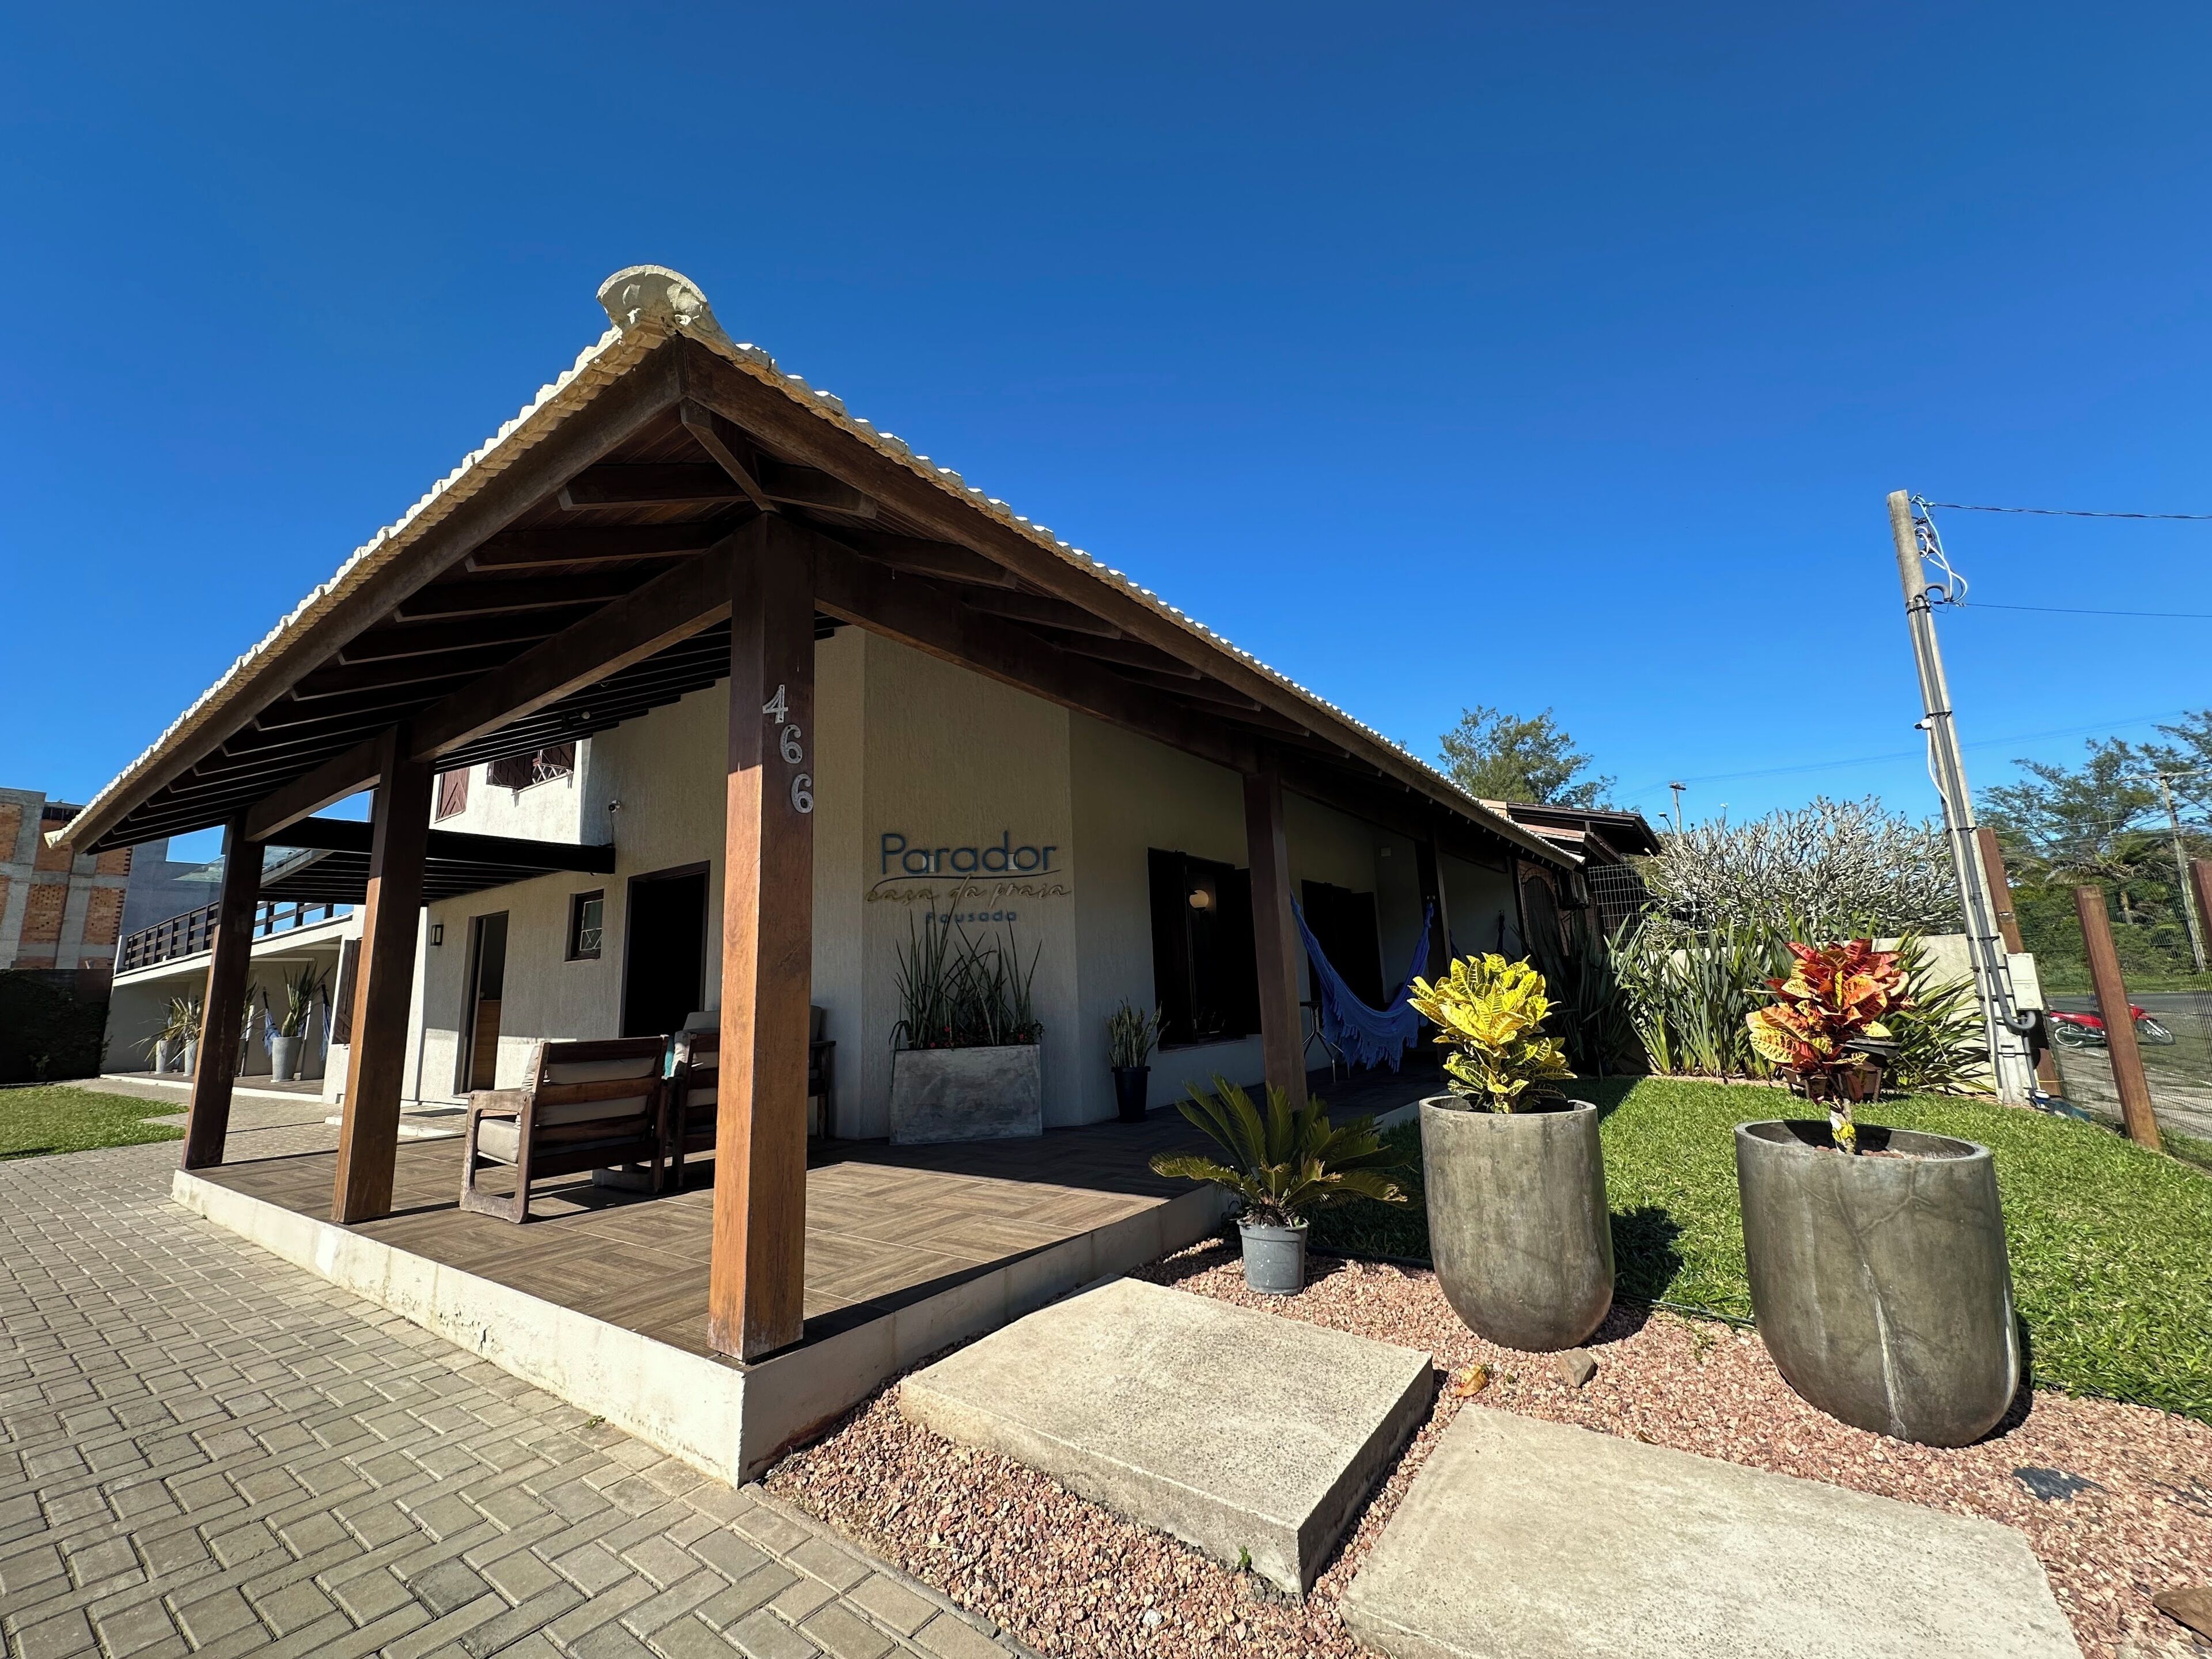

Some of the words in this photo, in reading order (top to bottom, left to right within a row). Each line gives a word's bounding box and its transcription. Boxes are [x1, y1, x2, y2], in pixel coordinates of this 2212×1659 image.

[762, 684, 814, 814] 466
[880, 830, 1057, 875] Parador
[865, 887, 940, 905] casa
[949, 873, 987, 907] da
[988, 881, 1072, 908] praia
